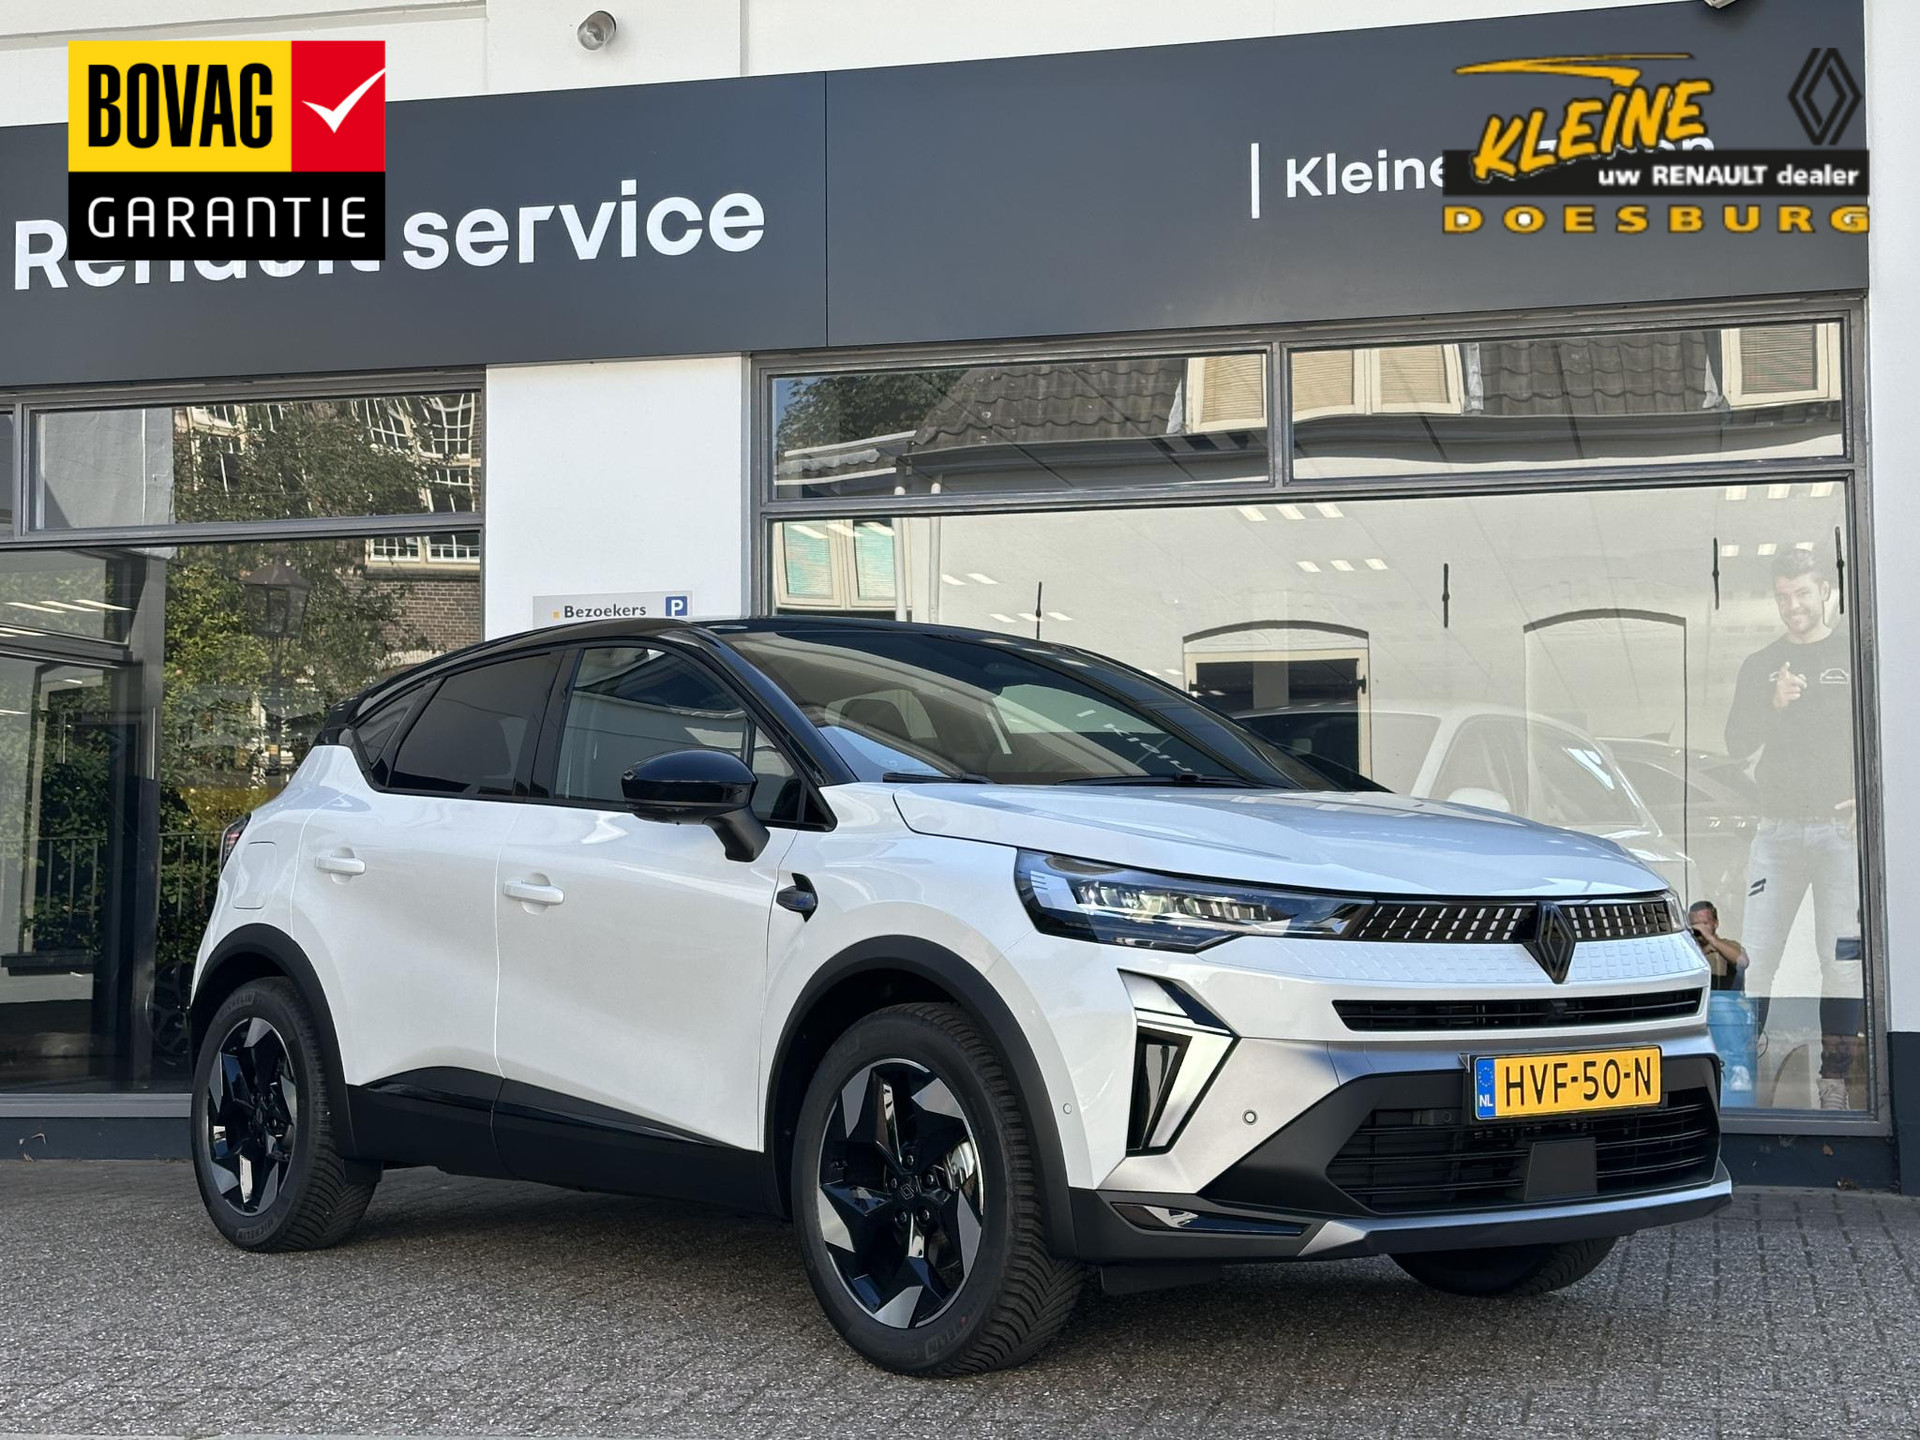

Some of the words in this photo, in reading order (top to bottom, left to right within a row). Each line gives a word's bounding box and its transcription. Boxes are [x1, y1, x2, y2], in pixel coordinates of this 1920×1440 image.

[402, 179, 766, 271] service
[564, 603, 647, 618] Bezoekers
[671, 599, 684, 616] P
[1479, 1094, 1493, 1108] NL
[1505, 1056, 1651, 1107] HVF-50-N
